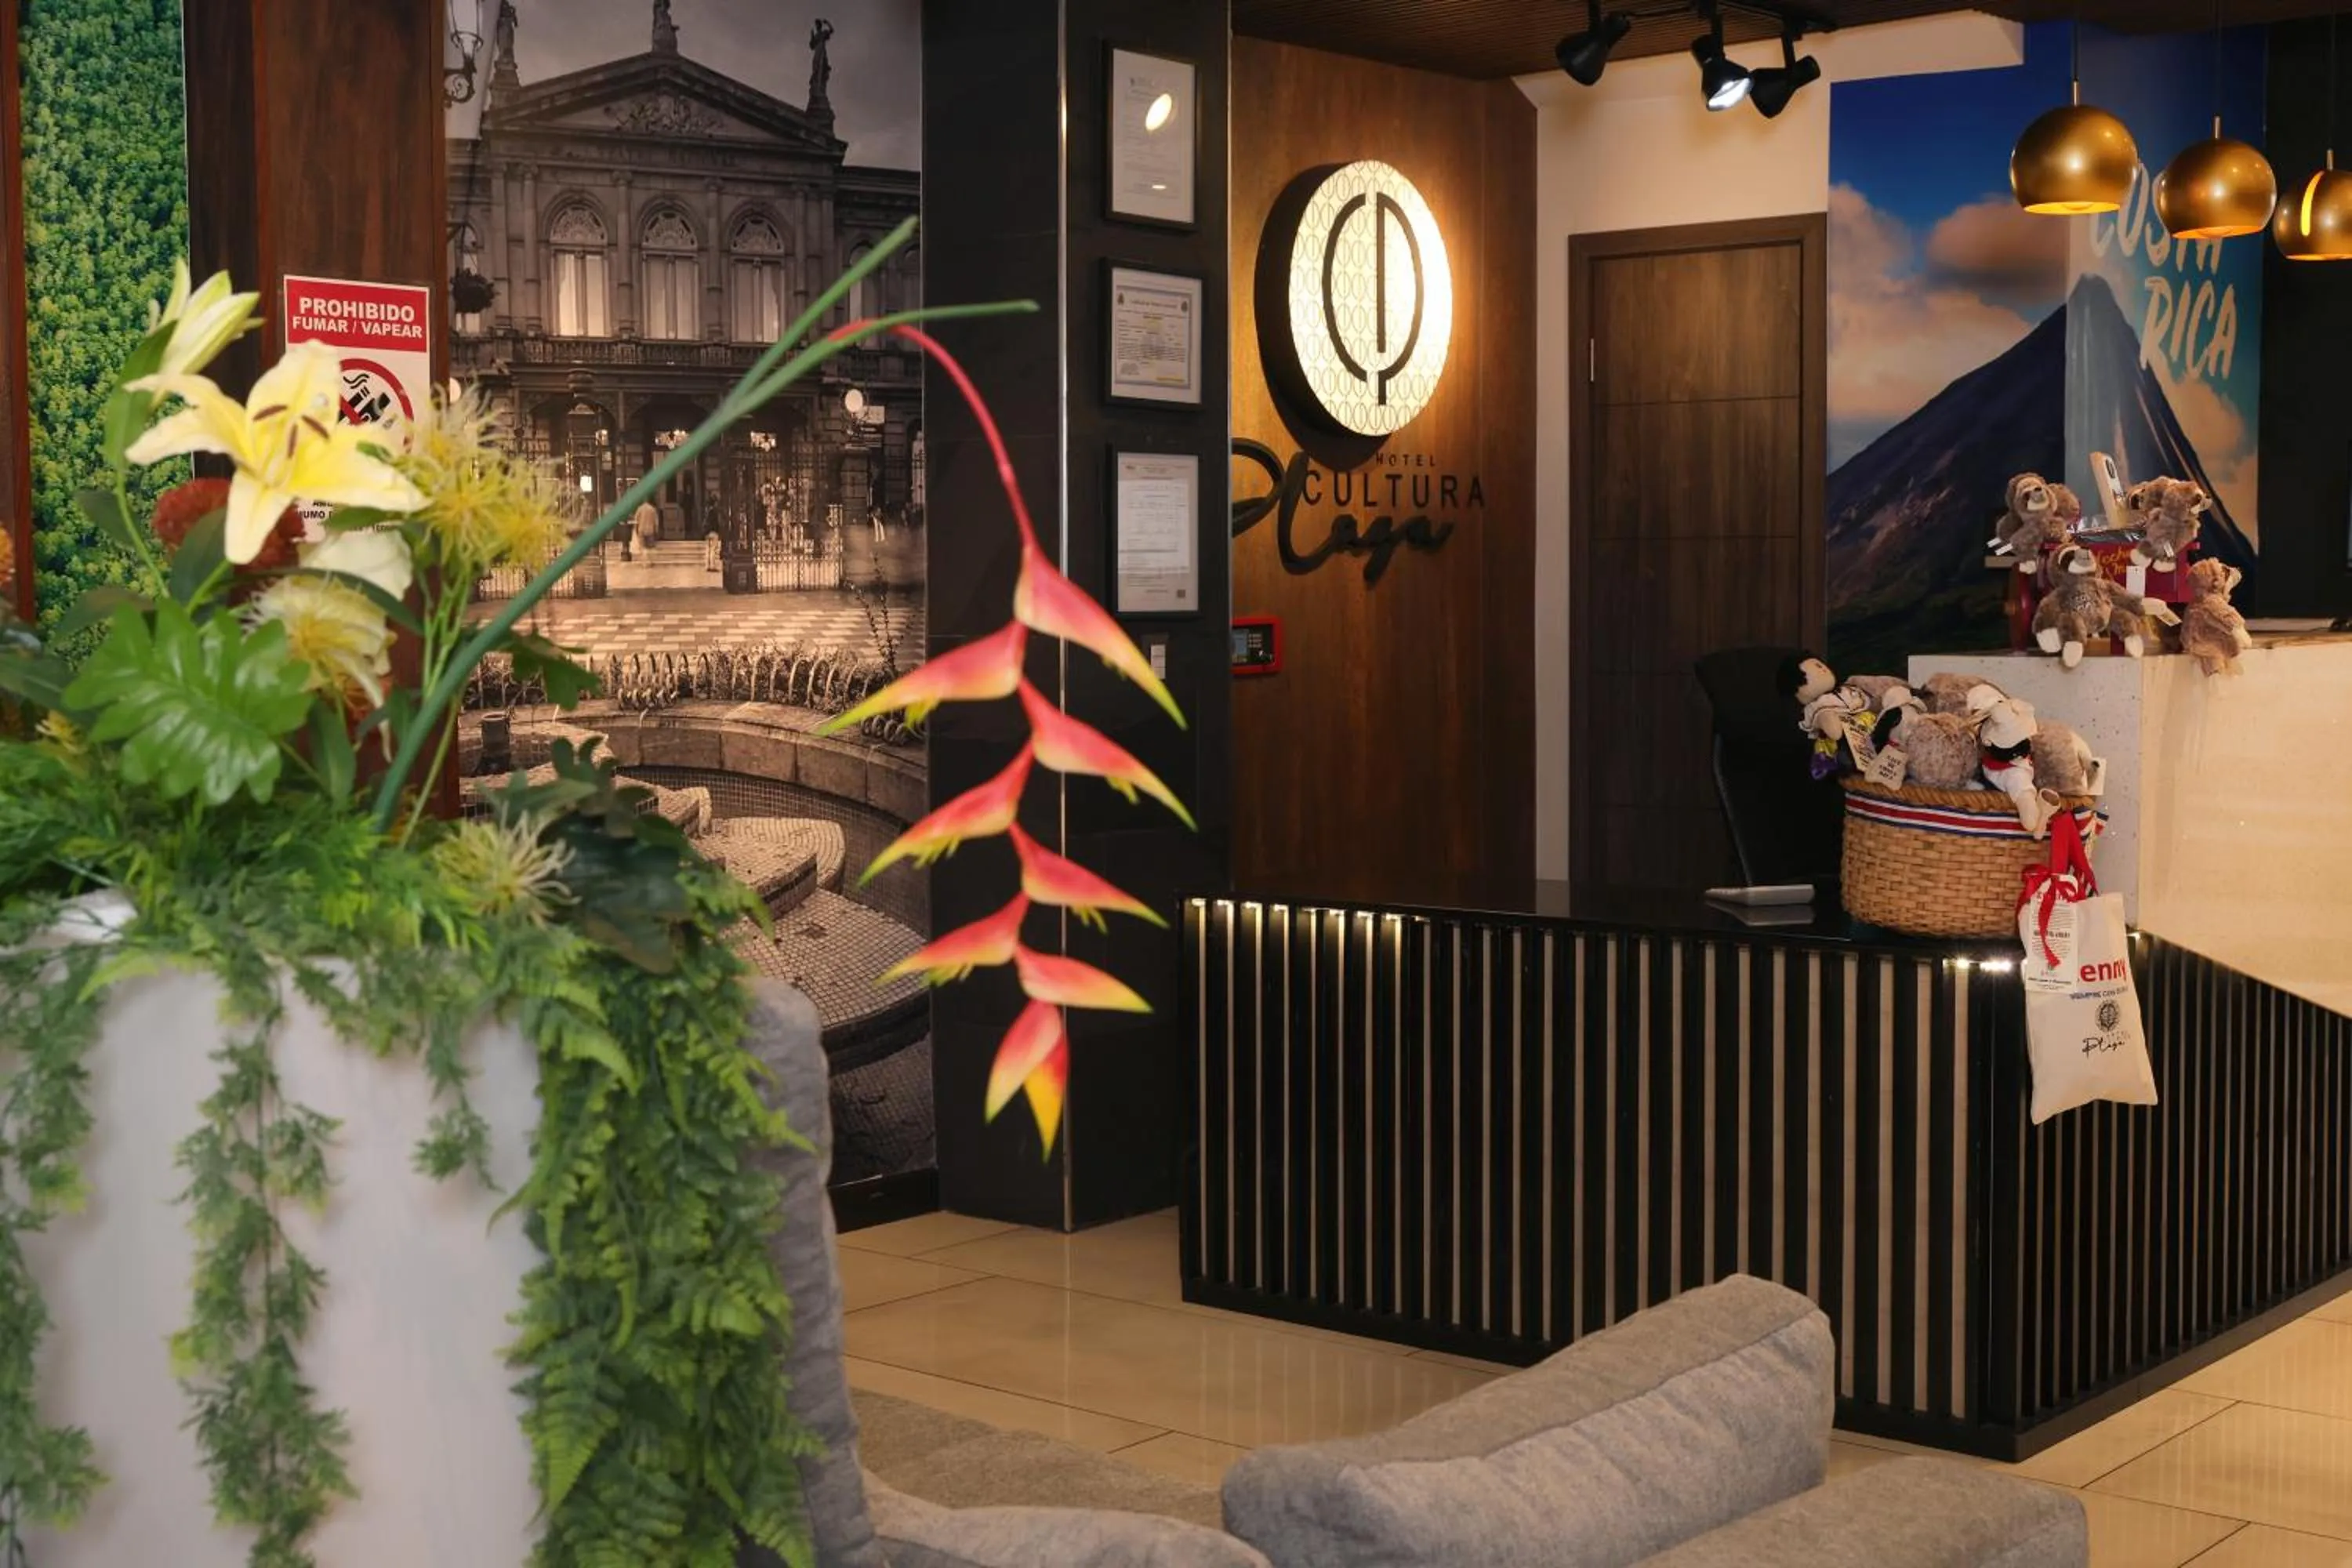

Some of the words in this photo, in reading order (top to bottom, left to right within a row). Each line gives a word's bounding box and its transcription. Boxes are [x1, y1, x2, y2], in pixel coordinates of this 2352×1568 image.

[299, 297, 415, 322] PROHIBIDO
[292, 316, 349, 333] FUMAR
[361, 322, 423, 338] VAPEAR
[2140, 276, 2238, 379] RICA
[1375, 452, 1436, 466] HOTEL
[1301, 470, 1486, 509] CULTURA
